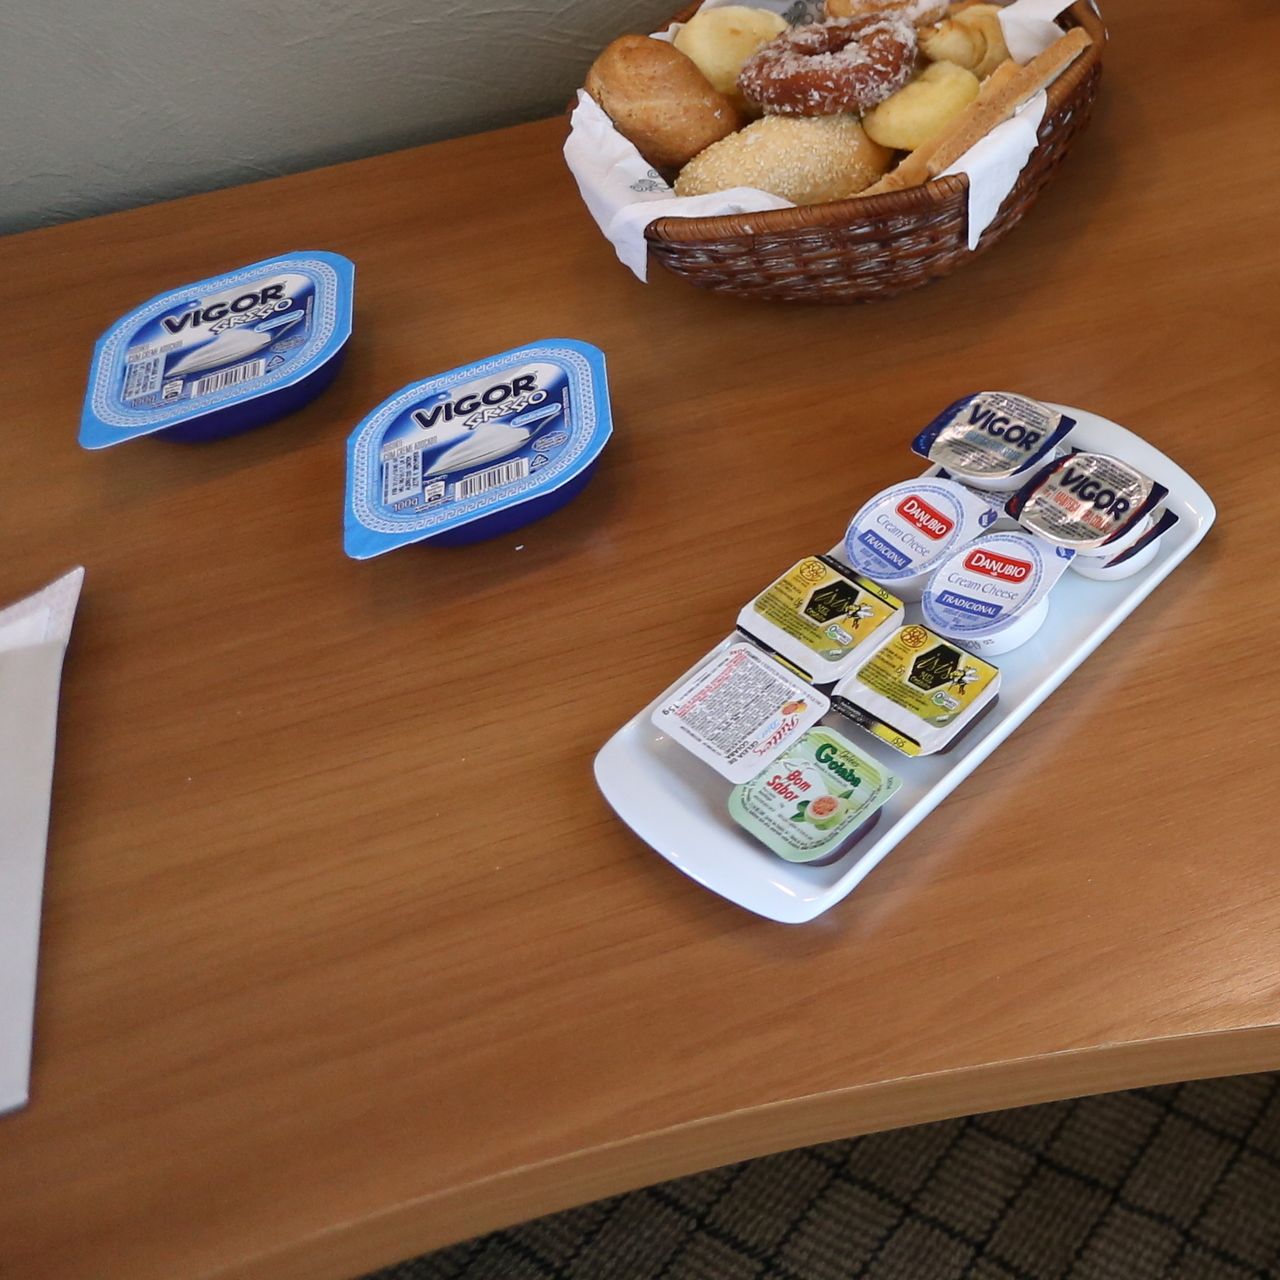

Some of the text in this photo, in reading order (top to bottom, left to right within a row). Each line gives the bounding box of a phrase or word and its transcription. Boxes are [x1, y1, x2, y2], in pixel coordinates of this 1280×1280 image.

[162, 282, 286, 335] VIGOR
[412, 373, 538, 429] VIGOR
[968, 403, 1042, 451] VIGOR
[392, 496, 419, 513] 100g
[1059, 466, 1130, 521] VIGOR
[864, 533, 907, 567] TRADICIONAL
[876, 513, 931, 557] Cream Cheese
[947, 572, 1019, 600] Cream Cheese
[941, 593, 997, 615] TRADICIONAL
[662, 702, 680, 716] 15g
[786, 769, 812, 793] Bom
[814, 742, 862, 788] Goiaba
[766, 775, 800, 802] Sabor
